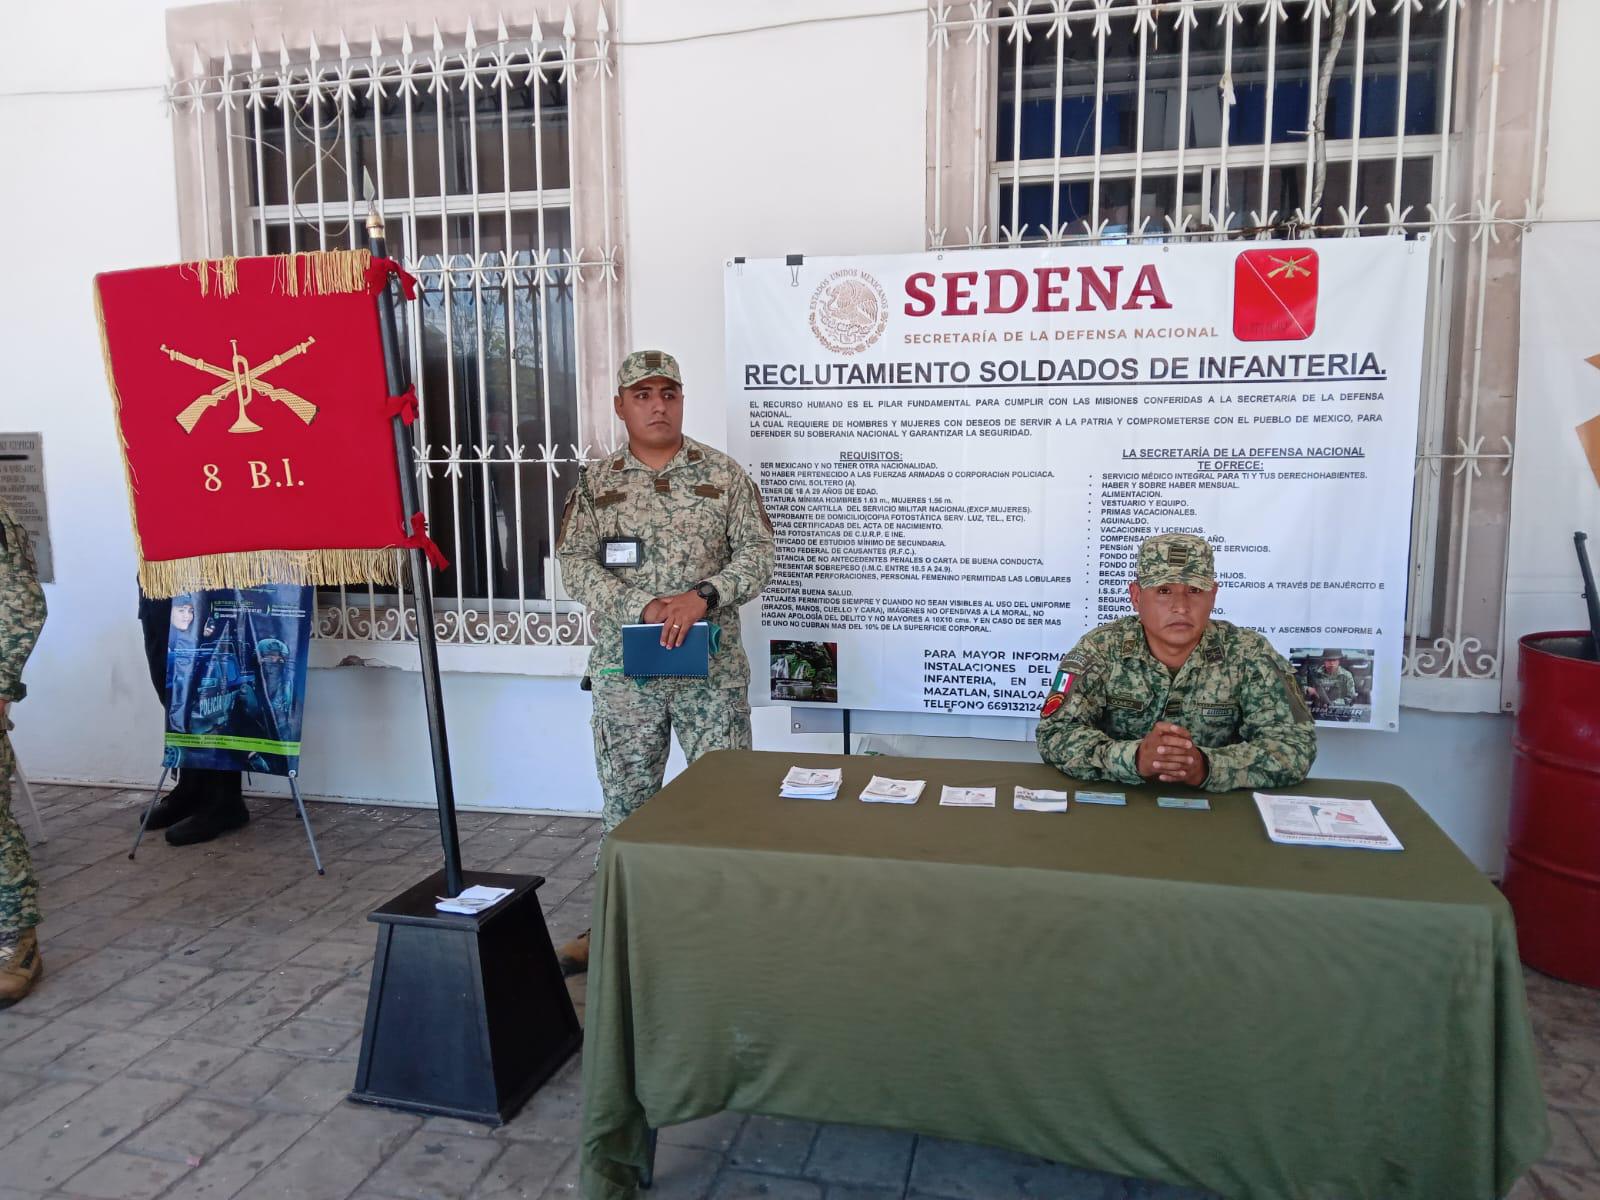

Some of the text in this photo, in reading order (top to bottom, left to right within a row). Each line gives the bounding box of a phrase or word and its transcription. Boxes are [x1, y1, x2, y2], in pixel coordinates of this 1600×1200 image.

[830, 269, 858, 281] UNIDOS
[861, 271, 888, 310] MEXICANOS
[904, 264, 1173, 317] SEDENA
[904, 326, 1219, 344] SECRETARÍA DE LA DEFENSA NACIONAL
[744, 351, 1387, 386] RECLUTAMIENTO SOLDADOS DE INFANTERIA.
[750, 392, 1384, 408] EL RECURSO HUMANO ES EL PILAR FUNDAMENTAL PARA CUMPLIR CON LAS MISIONES CONFERIDAS A LA SECRETARIA DE LA DEFENSA
[750, 420, 760, 428] LA
[762, 420, 784, 428] CUAL
[787, 420, 830, 428] REQUIERE
[832, 420, 844, 428] DE
[900, 419, 940, 427] MUJERES
[944, 419, 963, 427] CON
[966, 419, 1002, 427] DESEOS
[1004, 419, 1017, 427] DE
[1020, 418, 1052, 427] SERVIR
[1054, 418, 1062, 426] A
[1065, 417, 1077, 426] LA
[1080, 417, 1114, 426] PATRIA
[1117, 417, 1123, 425] Y
[1126, 416, 1210, 425] COMPROMETERSE
[1214, 415, 1234, 424] CON
[1238, 415, 1250, 424] EL
[1254, 415, 1292, 424] PUEBLO
[1296, 415, 1308, 423] DE
[1313, 414, 1354, 424] MEXICO,
[1357, 414, 1383, 423] PARA
[750, 430, 792, 438] DEFENDER
[910, 429, 964, 437] GARANTIZAR
[966, 429, 976, 437] LA
[978, 429, 1032, 437] SEGURIDAD.
[840, 451, 903, 460] REQUISITOS:
[1122, 446, 1365, 458] LA SECRETARÍA DE LA DEFENSA NACIONAL
[1198, 460, 1264, 470] TE OFRECE:
[203, 458, 305, 492] 8 B.I.
[1141, 471, 1174, 480] MÉDICO
[1174, 472, 1214, 480] INTEGRAL
[1100, 508, 1197, 516] PRIMAS VACACIONALES.
[1100, 526, 1151, 534] VACACIONES
[1154, 526, 1159, 534] Y
[1208, 535, 1226, 543] AÑO.
[774, 571, 814, 579] PRESENTAR
[816, 572, 878, 581] PERFORACIONES,
[880, 573, 920, 581] PERSONAL
[962, 574, 1006, 582] PERMITIDAS
[1024, 575, 1072, 583] LOBULARES
[1220, 572, 1246, 580] HIJOS.
[1276, 581, 1308, 589] TRAVÉS
[1323, 581, 1377, 590] BANJÉRCITO
[1379, 582, 1384, 590] E
[1324, 627, 1372, 635] CONFORME
[924, 650, 956, 659] PARA
[962, 650, 1006, 660] MAYOR
[924, 662, 1051, 674] INSTALACIONES DEL
[924, 675, 996, 686] INFANTERIA,
[1010, 677, 1026, 686] EN
[924, 688, 990, 698] MAZATLAN,
[924, 700, 984, 710] TELEFONO
